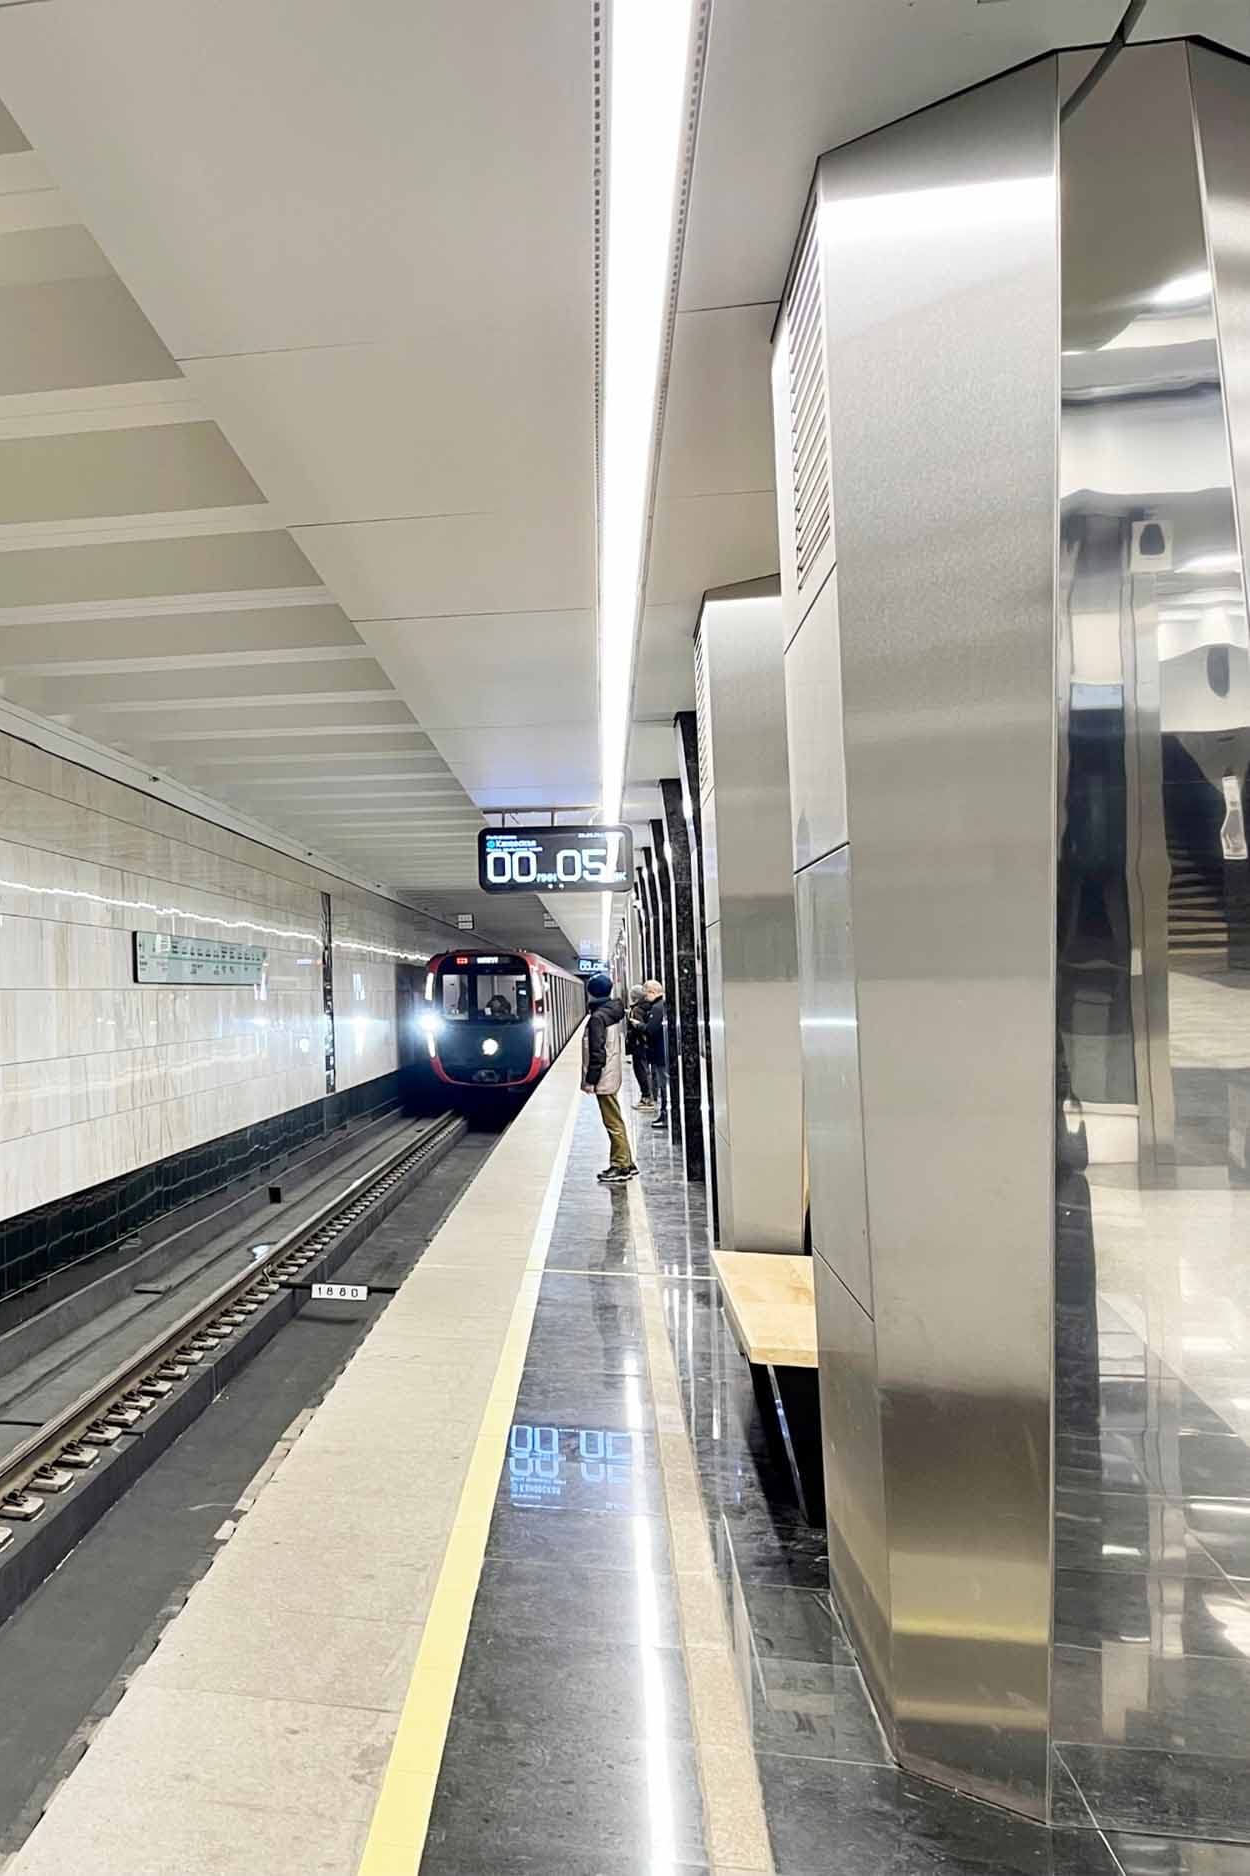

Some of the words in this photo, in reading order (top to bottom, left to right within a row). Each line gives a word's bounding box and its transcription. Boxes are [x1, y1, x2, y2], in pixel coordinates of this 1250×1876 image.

[486, 851, 537, 883] 00
[556, 849, 608, 882] 05
[317, 1286, 359, 1298] 1880
